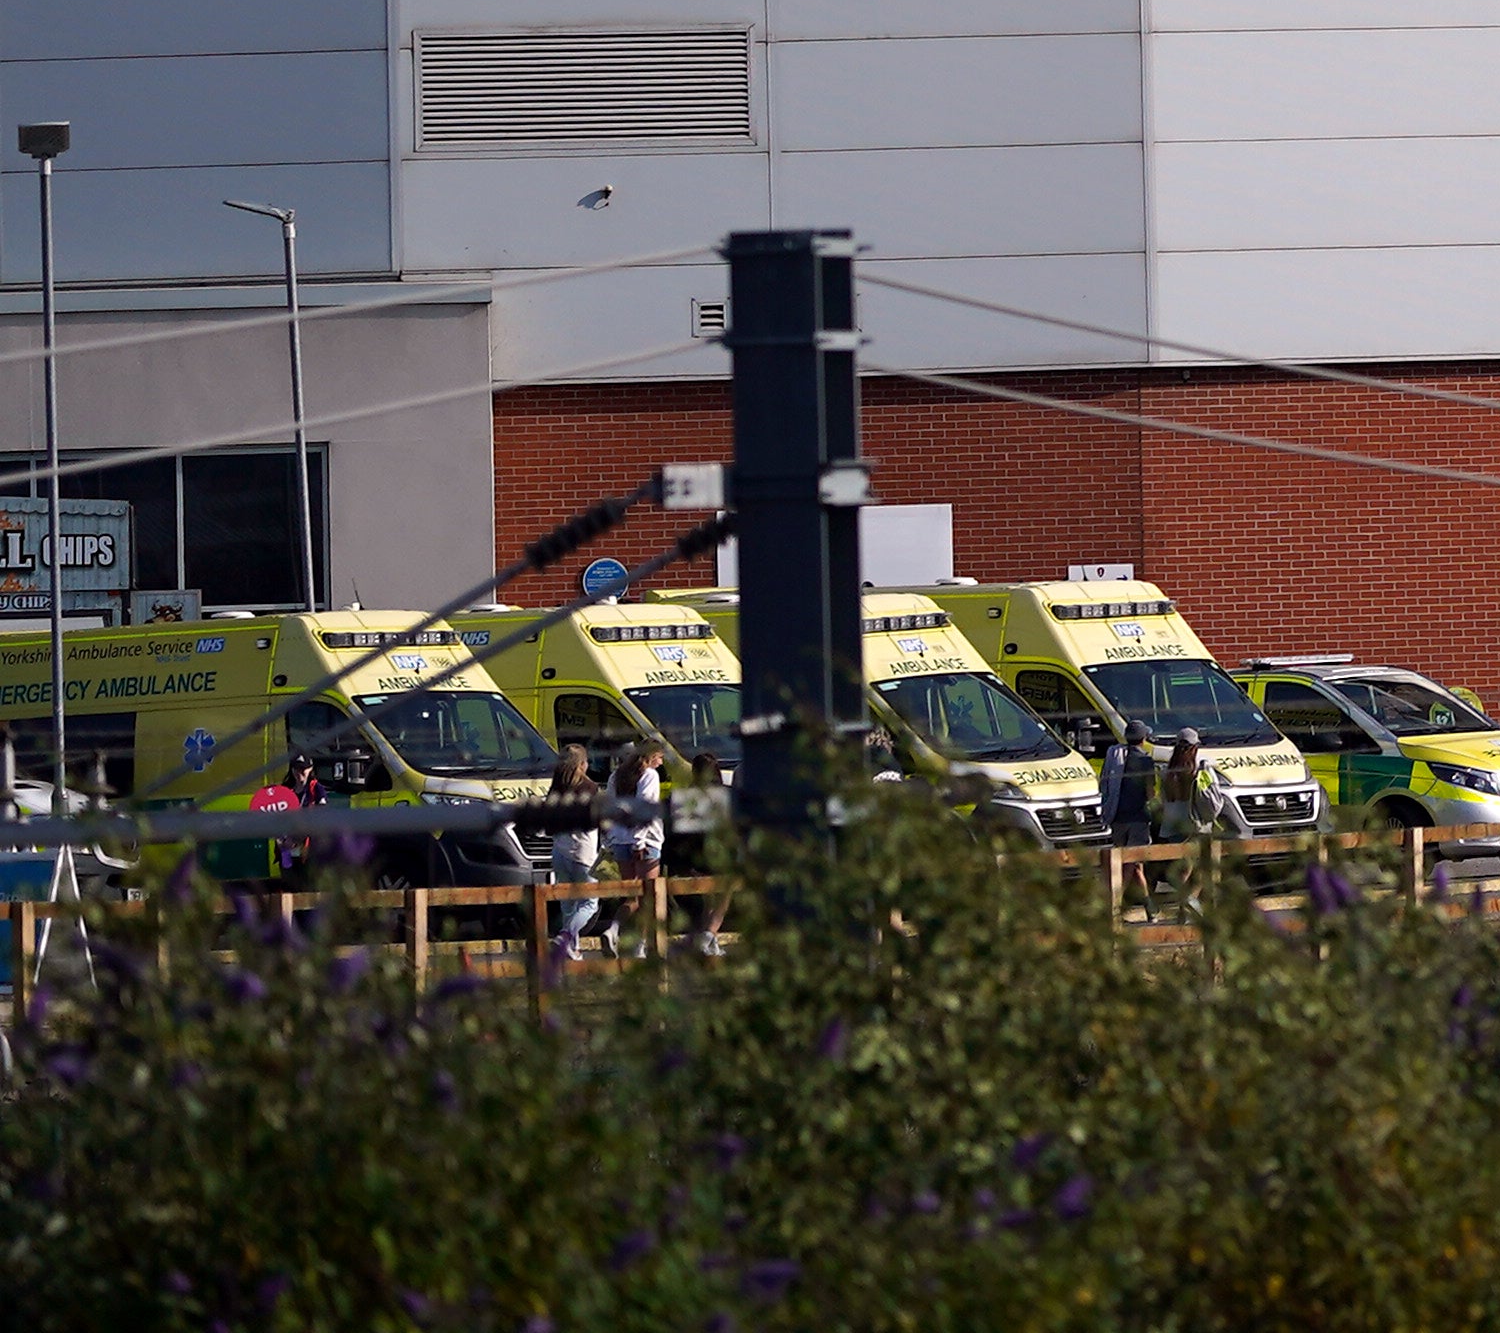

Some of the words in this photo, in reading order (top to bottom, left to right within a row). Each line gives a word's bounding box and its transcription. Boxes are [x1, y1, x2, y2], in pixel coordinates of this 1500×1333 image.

[1115, 623, 1145, 636] NHS
[462, 631, 490, 645] NHS
[1, 648, 53, 665] Yorkshir
[66, 643, 143, 661] Ambulance
[146, 638, 194, 655] Service
[196, 638, 224, 653] NHS
[655, 647, 688, 661] NHS
[1103, 644, 1188, 660] AMBULANCE
[393, 655, 428, 669] NHS
[889, 658, 969, 675] AMBULANCE
[644, 668, 730, 684] AMBULANCE
[0, 680, 92, 706] ERGECY
[94, 671, 218, 700] AMBULANCE
